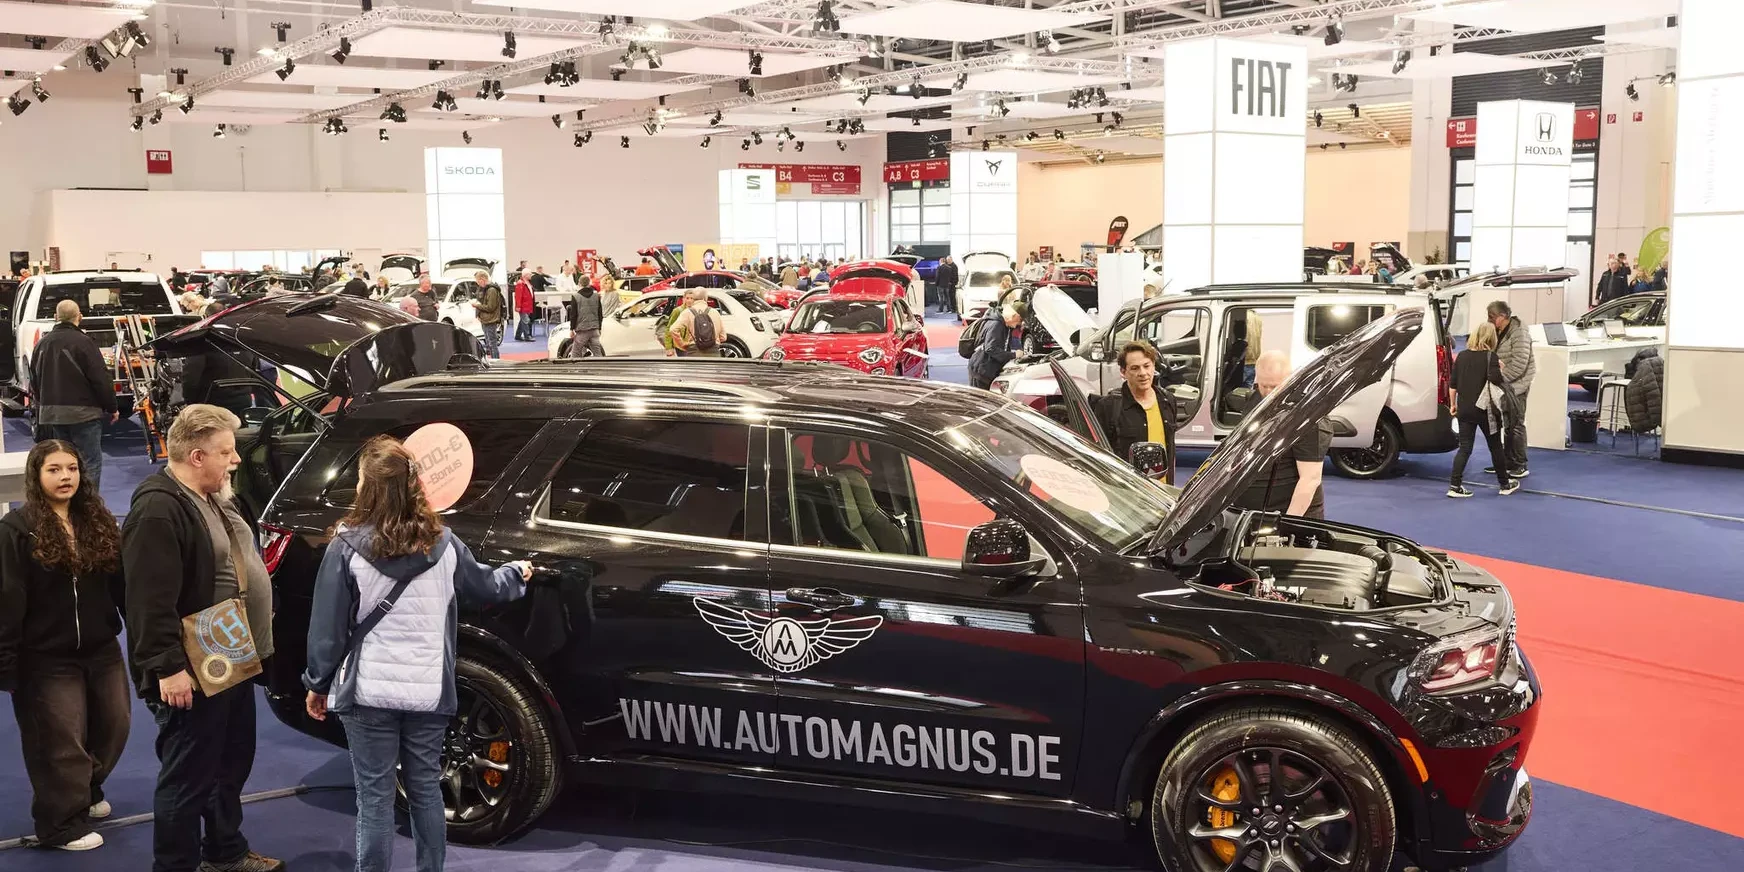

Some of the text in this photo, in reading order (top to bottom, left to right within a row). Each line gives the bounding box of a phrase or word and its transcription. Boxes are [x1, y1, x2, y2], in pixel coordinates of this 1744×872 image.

[1231, 57, 1292, 118] FIAT
[1524, 146, 1563, 156] HONDA
[779, 170, 792, 181] B4
[832, 171, 845, 182] C3
[910, 169, 920, 179] C3
[212, 608, 248, 647] H
[1099, 646, 1155, 656] HEMI
[619, 697, 1062, 781] WWW.AUTOMAGNUS.DE
